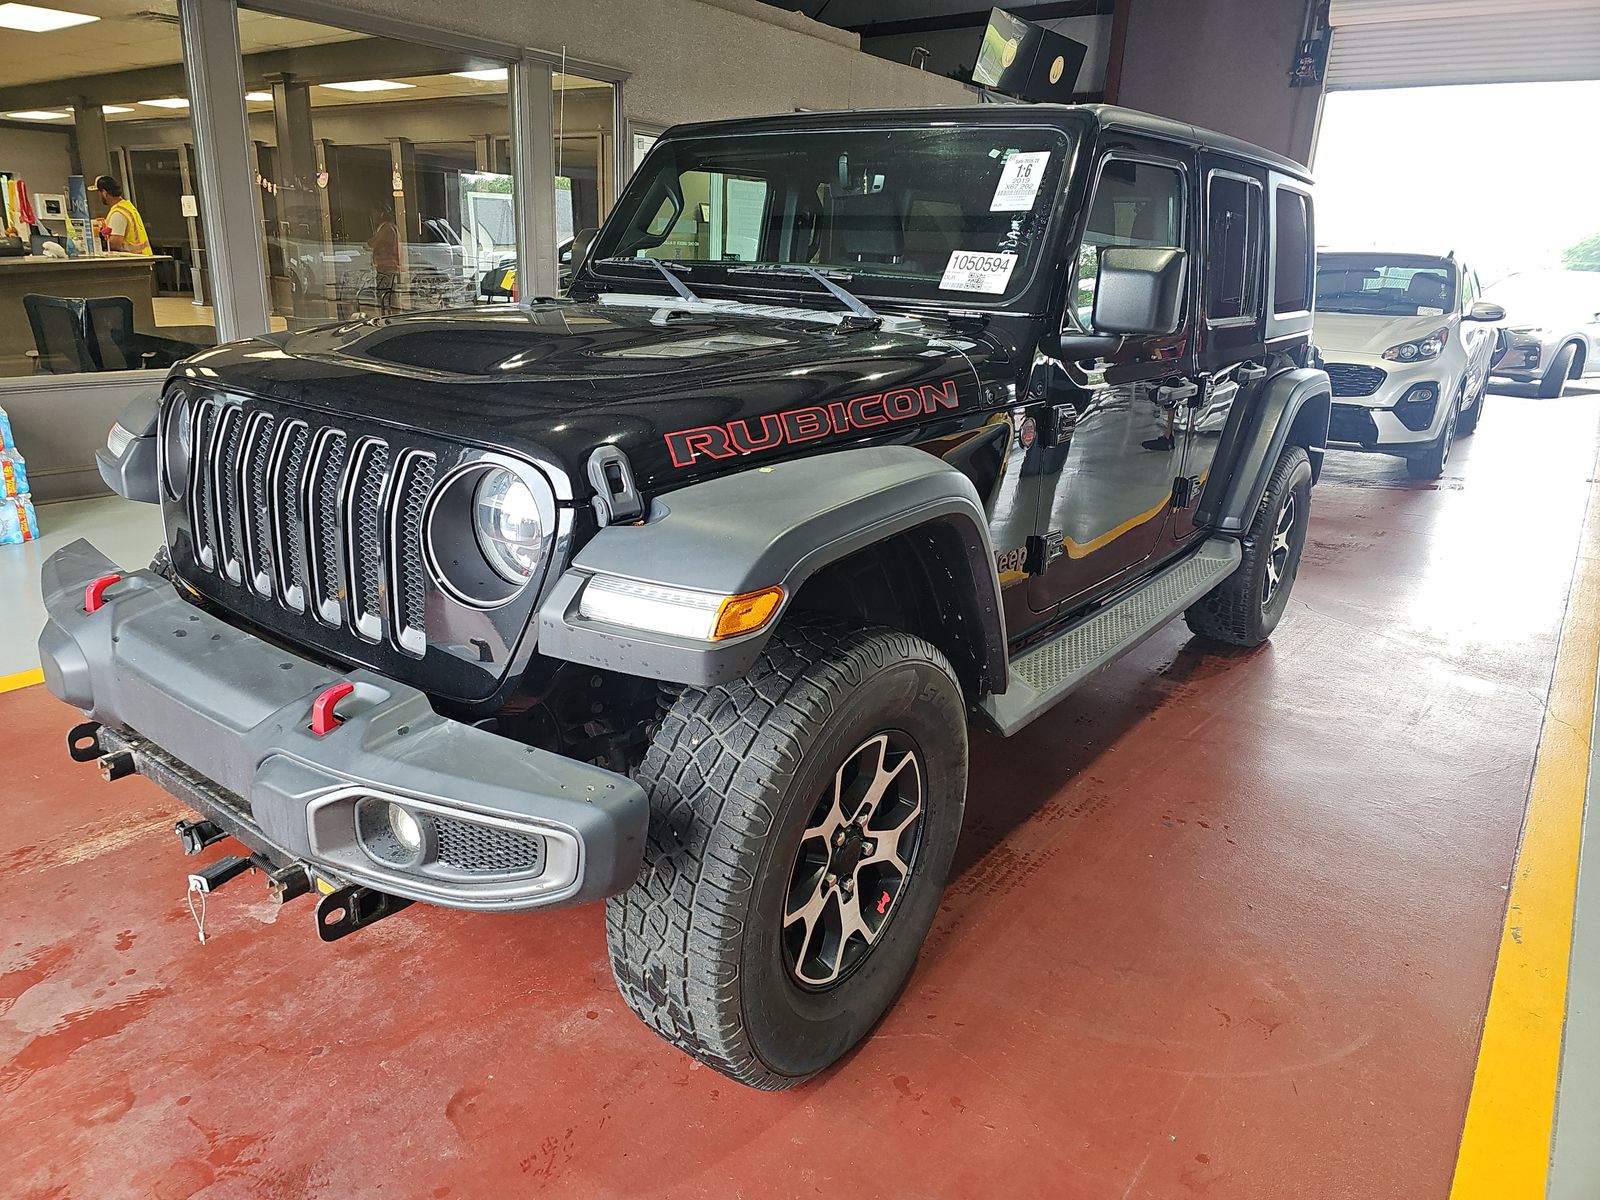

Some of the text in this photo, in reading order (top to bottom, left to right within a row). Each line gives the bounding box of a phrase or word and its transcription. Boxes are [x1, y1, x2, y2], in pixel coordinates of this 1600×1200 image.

[1017, 164, 1032, 177] 1:6
[953, 255, 1010, 272] 1050594
[664, 380, 959, 468] RUBICON
